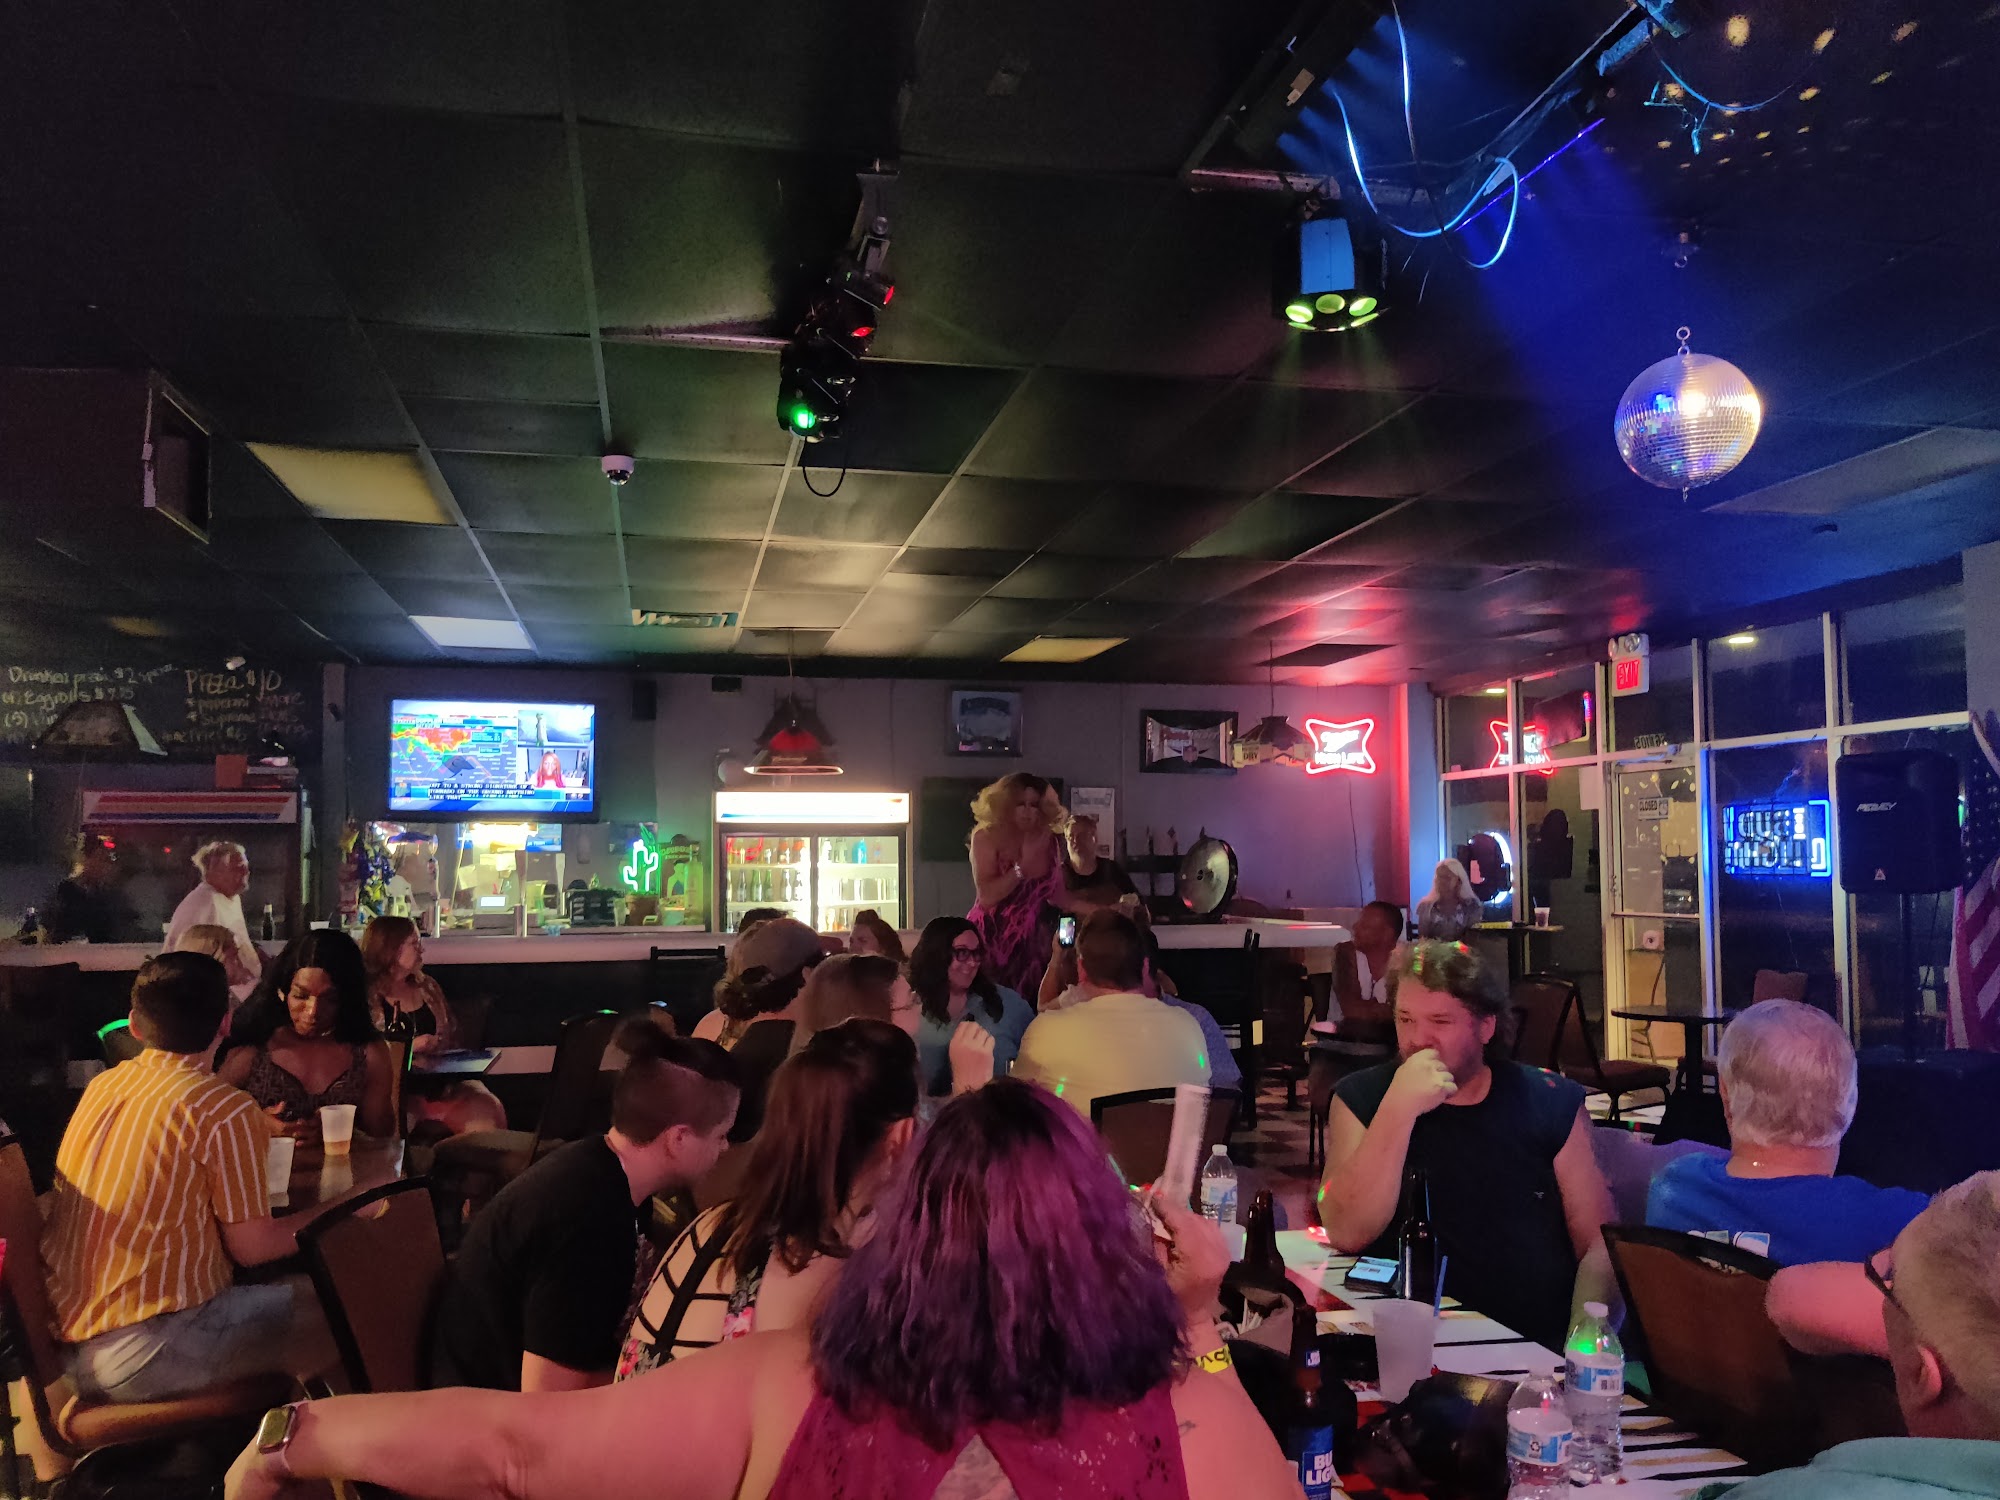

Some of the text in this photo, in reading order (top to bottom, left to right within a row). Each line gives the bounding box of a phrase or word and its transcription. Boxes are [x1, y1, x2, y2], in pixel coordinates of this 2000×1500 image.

[1617, 660, 1640, 690] EXIT
[1640, 800, 1658, 811] CLOSED
[1314, 1450, 1333, 1470] BU
[1305, 1466, 1332, 1485] LIG
